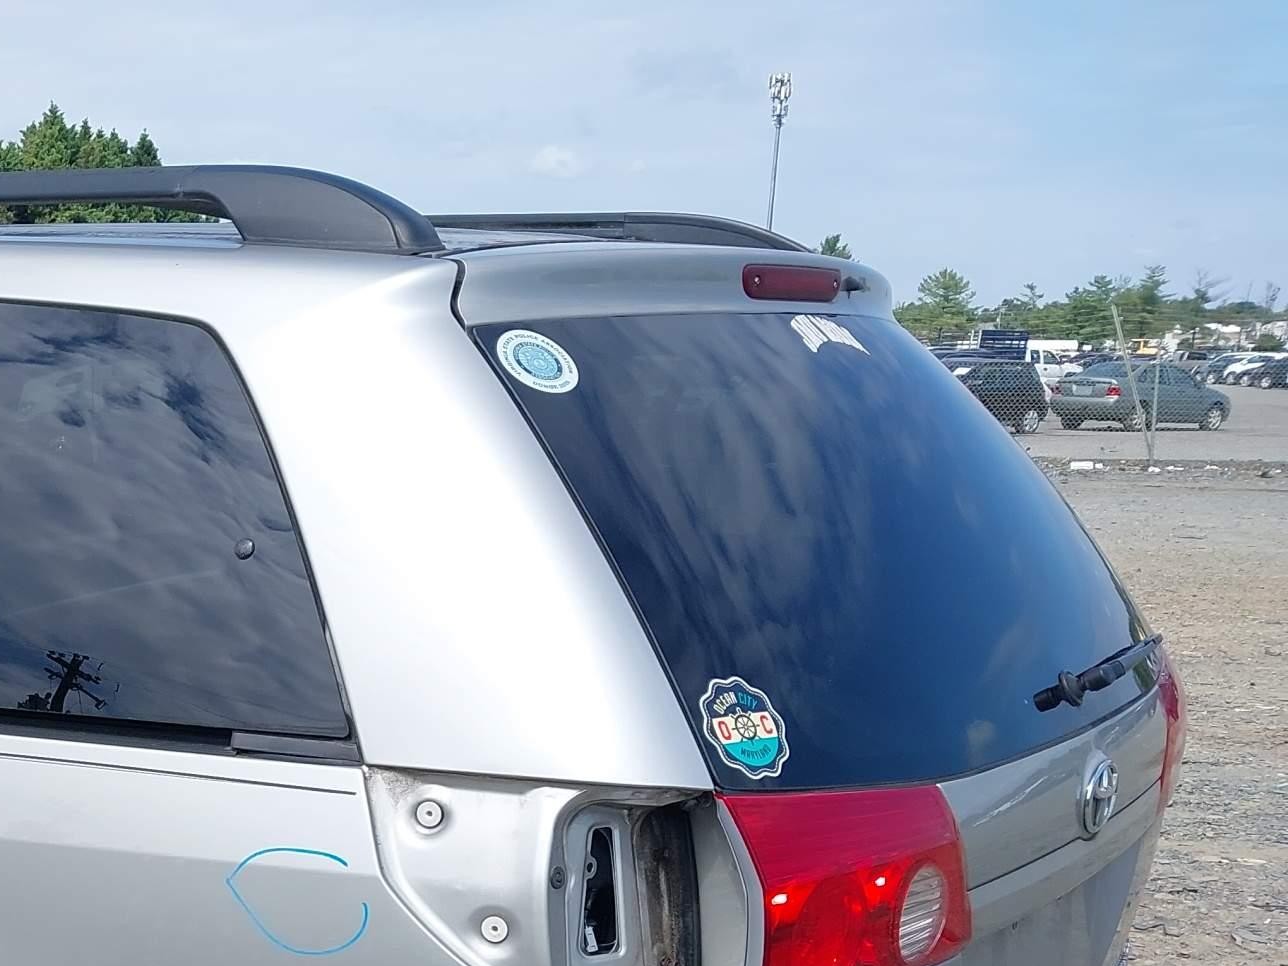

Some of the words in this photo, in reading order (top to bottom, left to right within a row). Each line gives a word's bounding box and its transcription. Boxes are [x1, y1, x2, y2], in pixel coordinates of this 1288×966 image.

[713, 691, 738, 715] OCEAN
[737, 692, 758, 710] CITY
[718, 721, 732, 741] O
[760, 715, 773, 734] C
